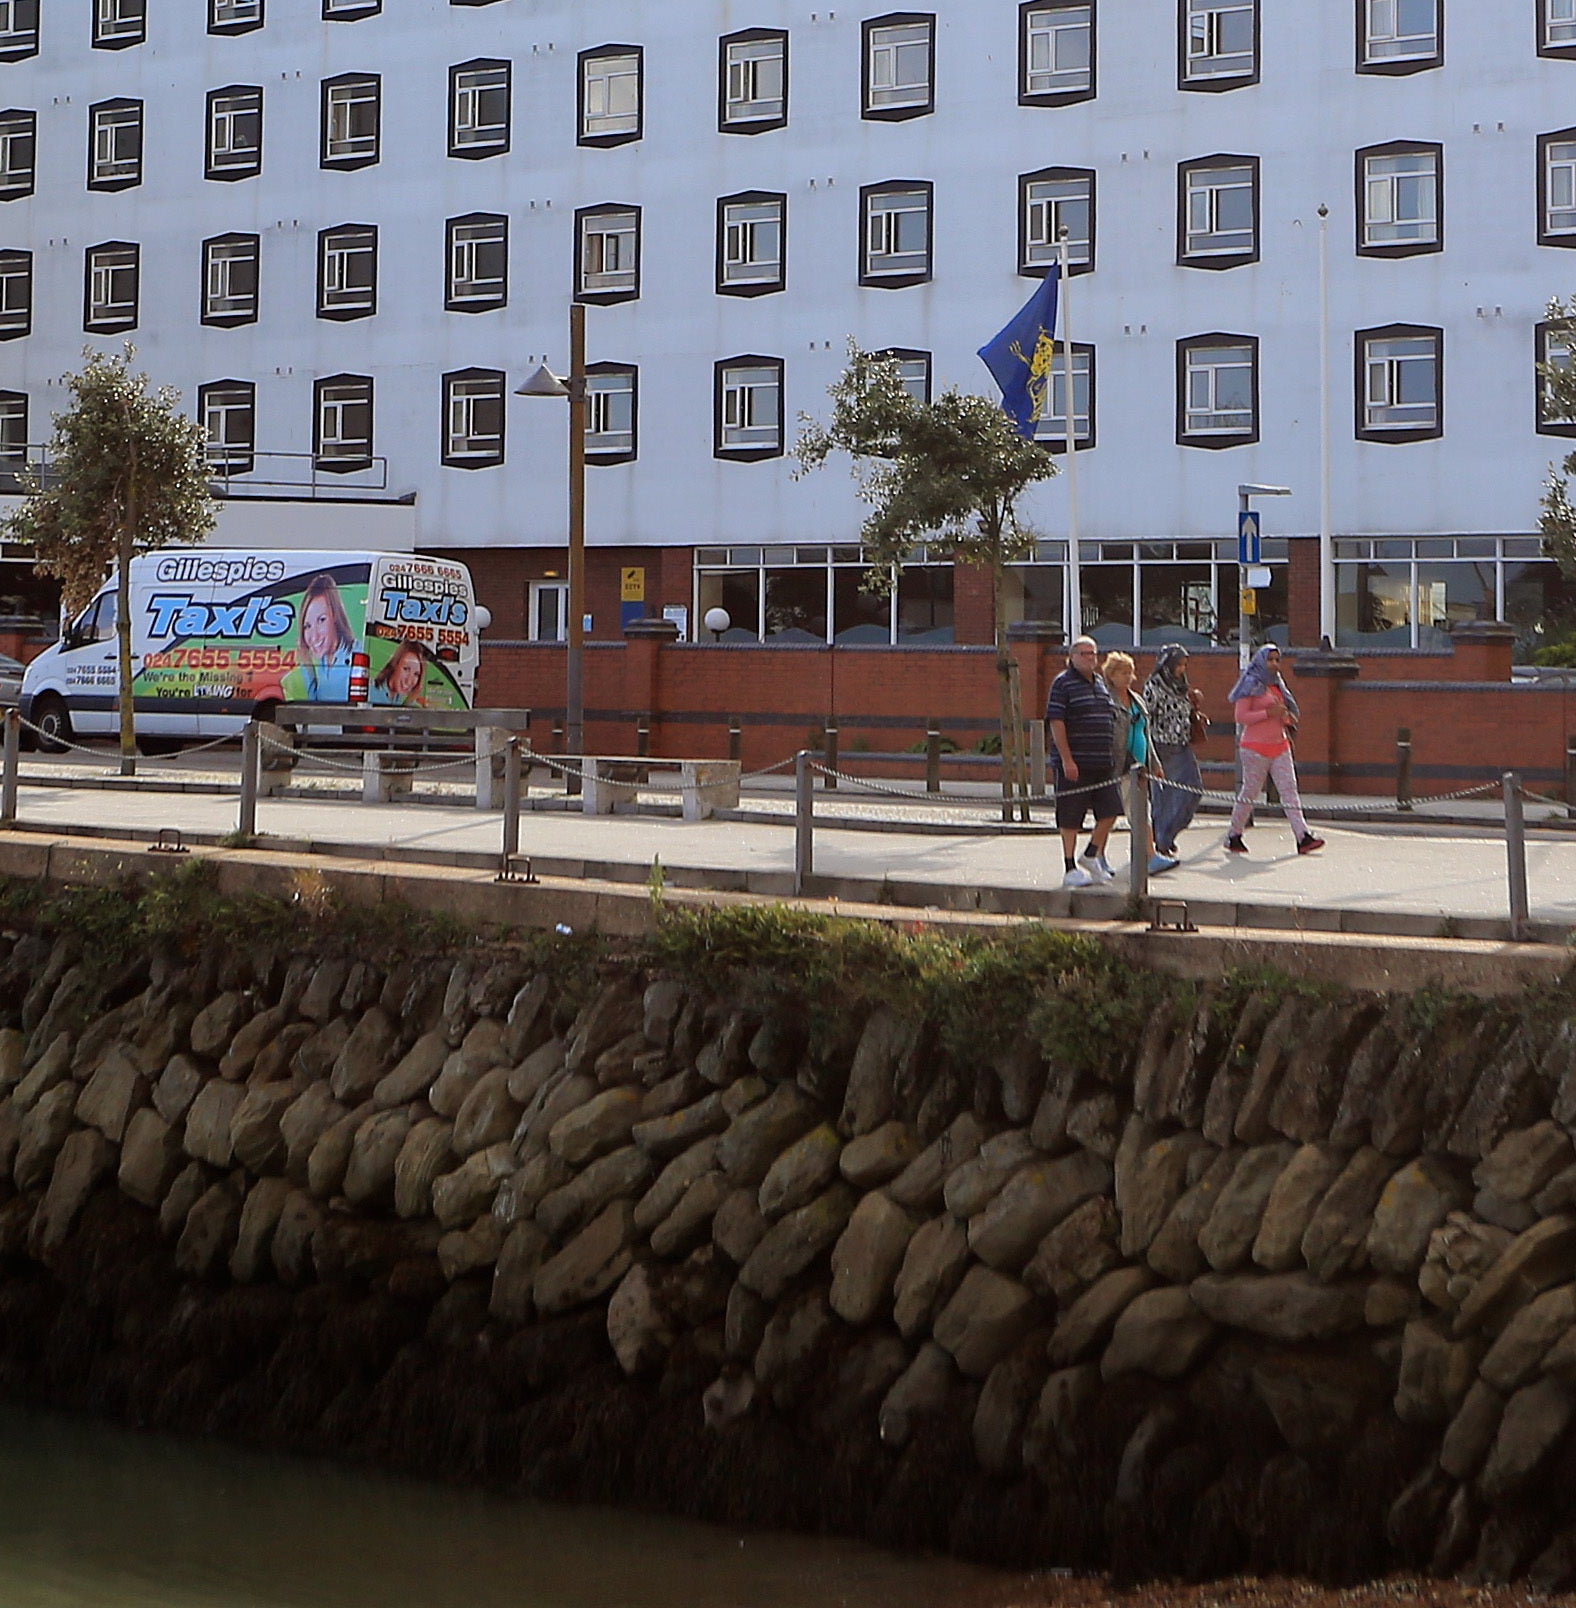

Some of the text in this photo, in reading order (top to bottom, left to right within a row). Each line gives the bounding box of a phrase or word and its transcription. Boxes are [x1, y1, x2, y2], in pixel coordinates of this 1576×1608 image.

[156, 557, 285, 586] Gillespies
[381, 573, 468, 597] Gillespies
[146, 593, 297, 638] Taxi's
[380, 588, 468, 626] Taxi's
[438, 628, 470, 646] 5554
[237, 649, 297, 672] 5554
[143, 671, 174, 682] We're
[178, 671, 196, 682] the
[199, 672, 243, 684] Missing
[156, 686, 190, 698] You're
[236, 686, 253, 697] for
